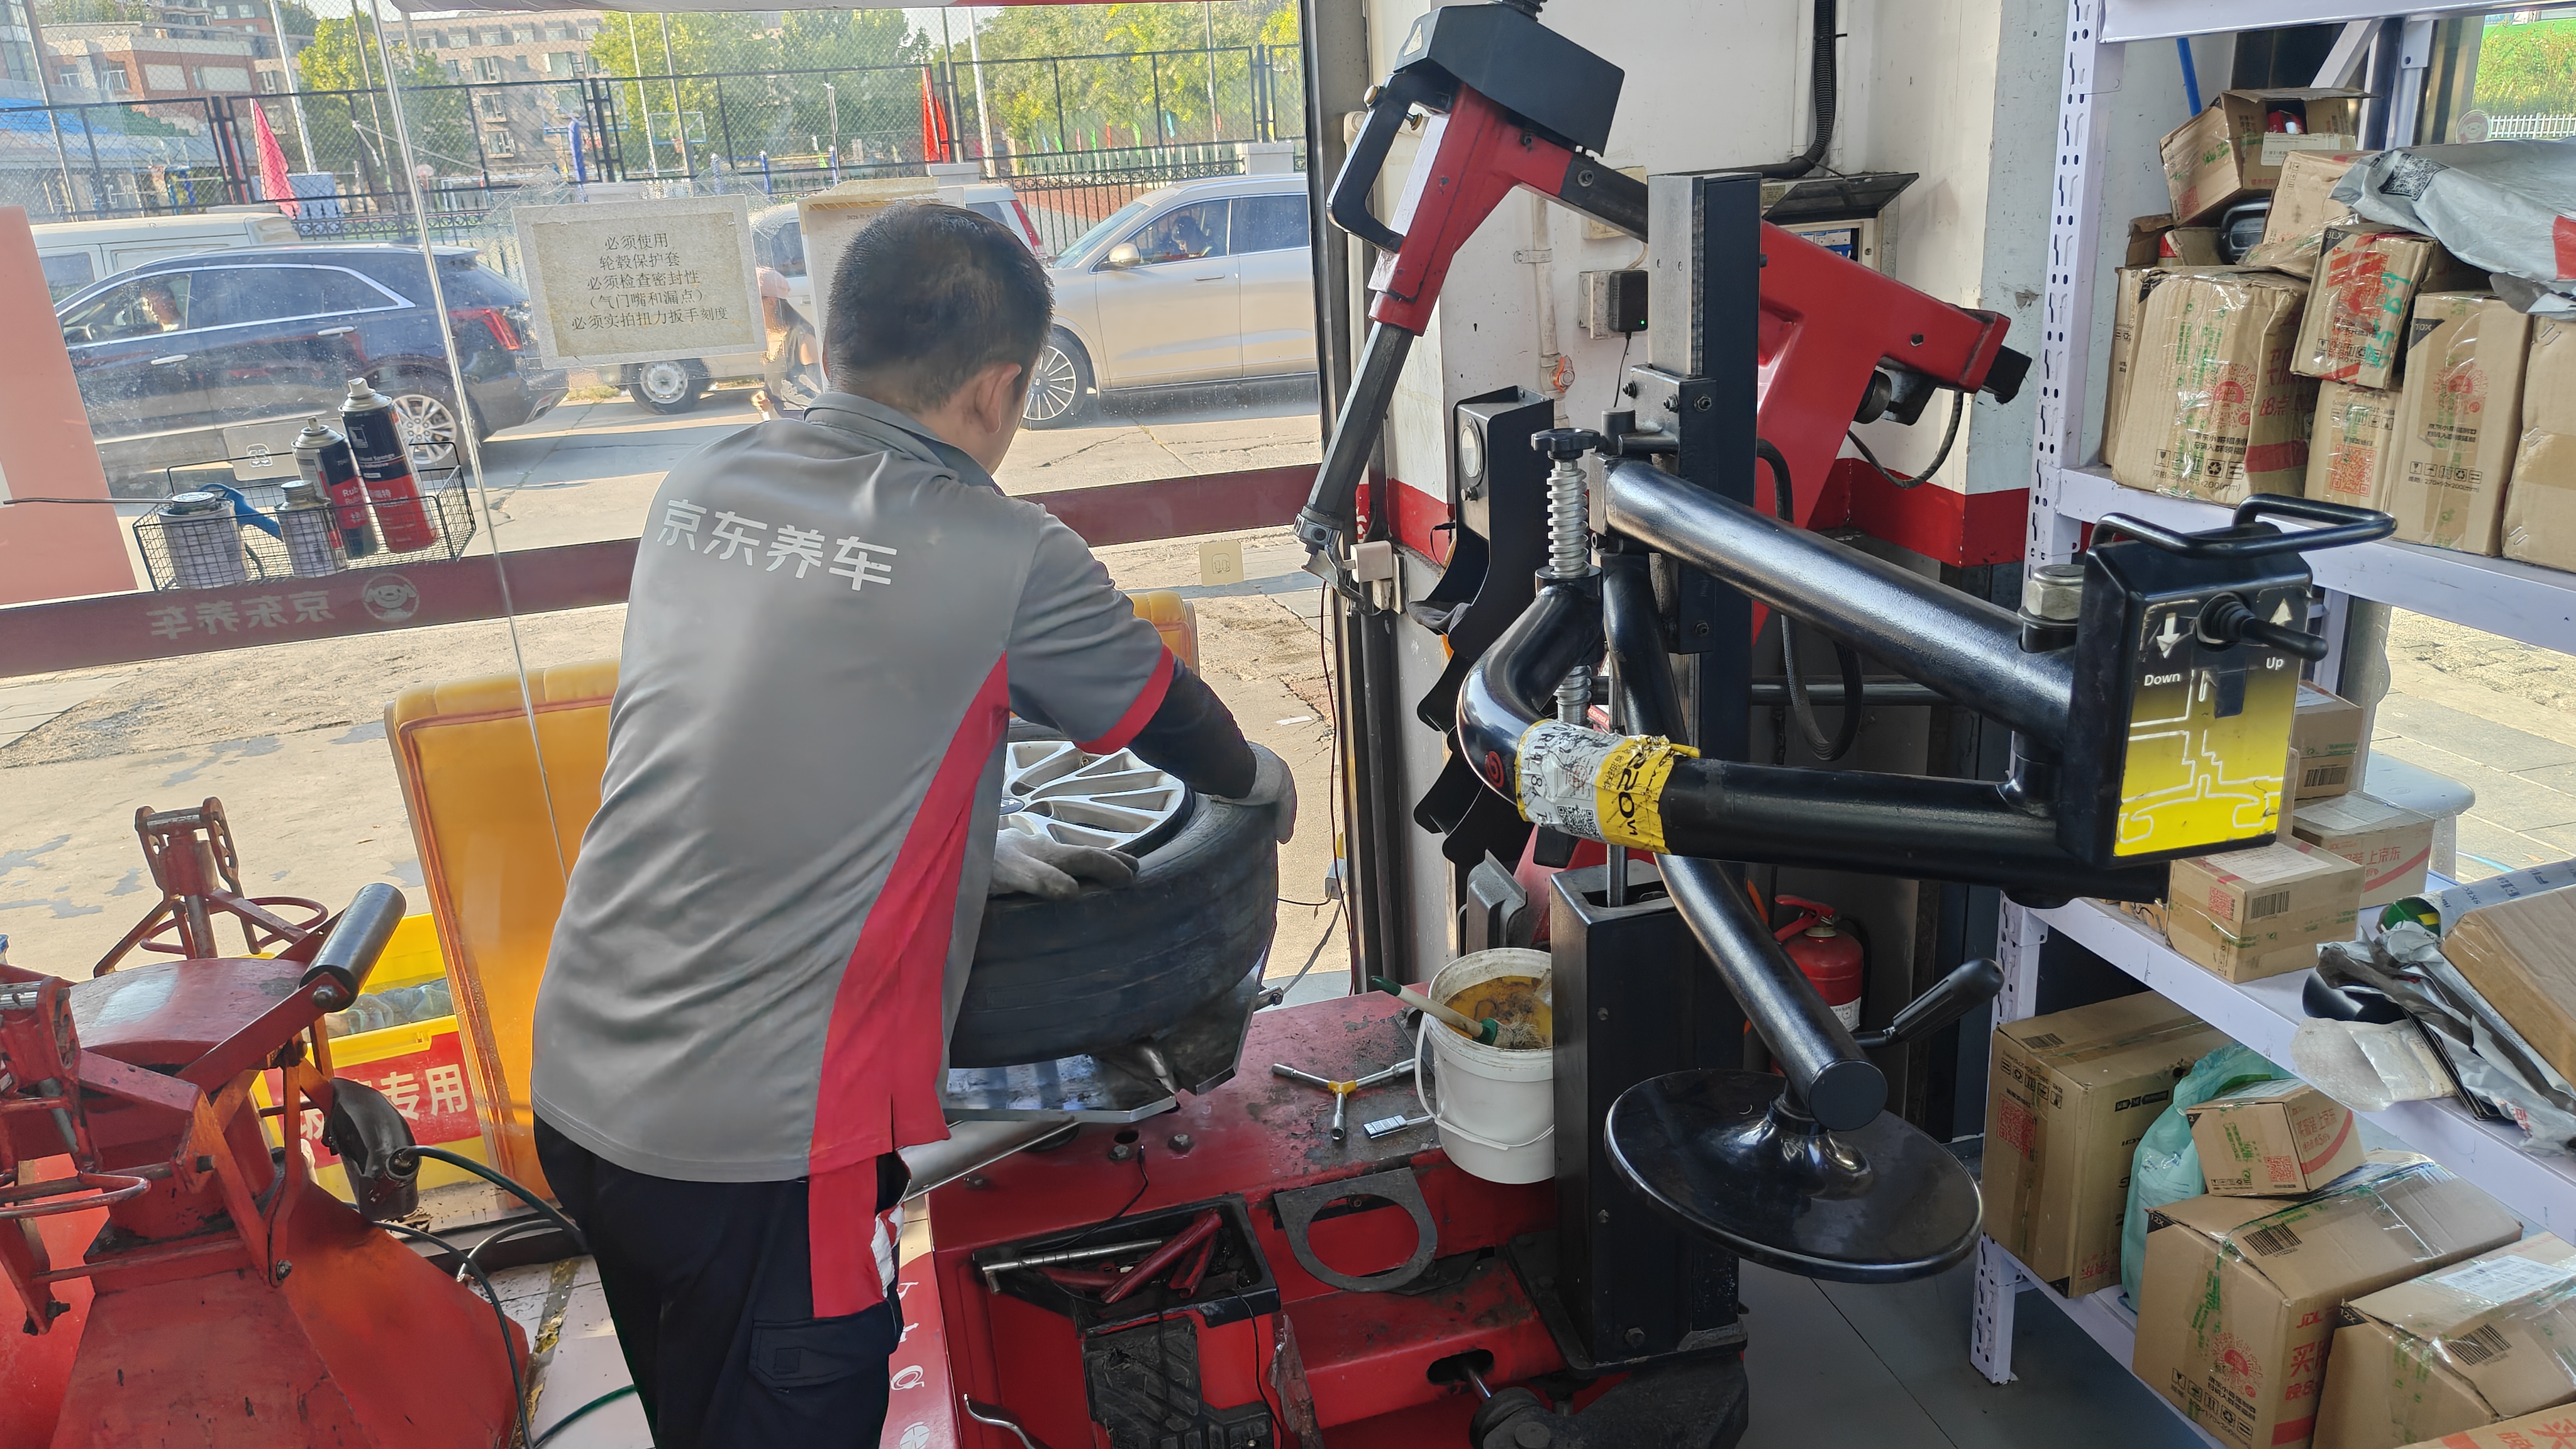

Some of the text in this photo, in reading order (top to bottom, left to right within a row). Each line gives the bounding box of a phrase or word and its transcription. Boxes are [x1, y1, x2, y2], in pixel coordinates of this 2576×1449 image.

[604, 233, 668, 251] 必须使用
[599, 252, 680, 270] 轮毂保护套
[587, 270, 701, 291] 必须检查密封性
[571, 306, 728, 331] 必须实拍扭力扳手刻度
[657, 498, 898, 591] 京东养车
[2266, 657, 2284, 671] Up
[2143, 672, 2181, 687] Down
